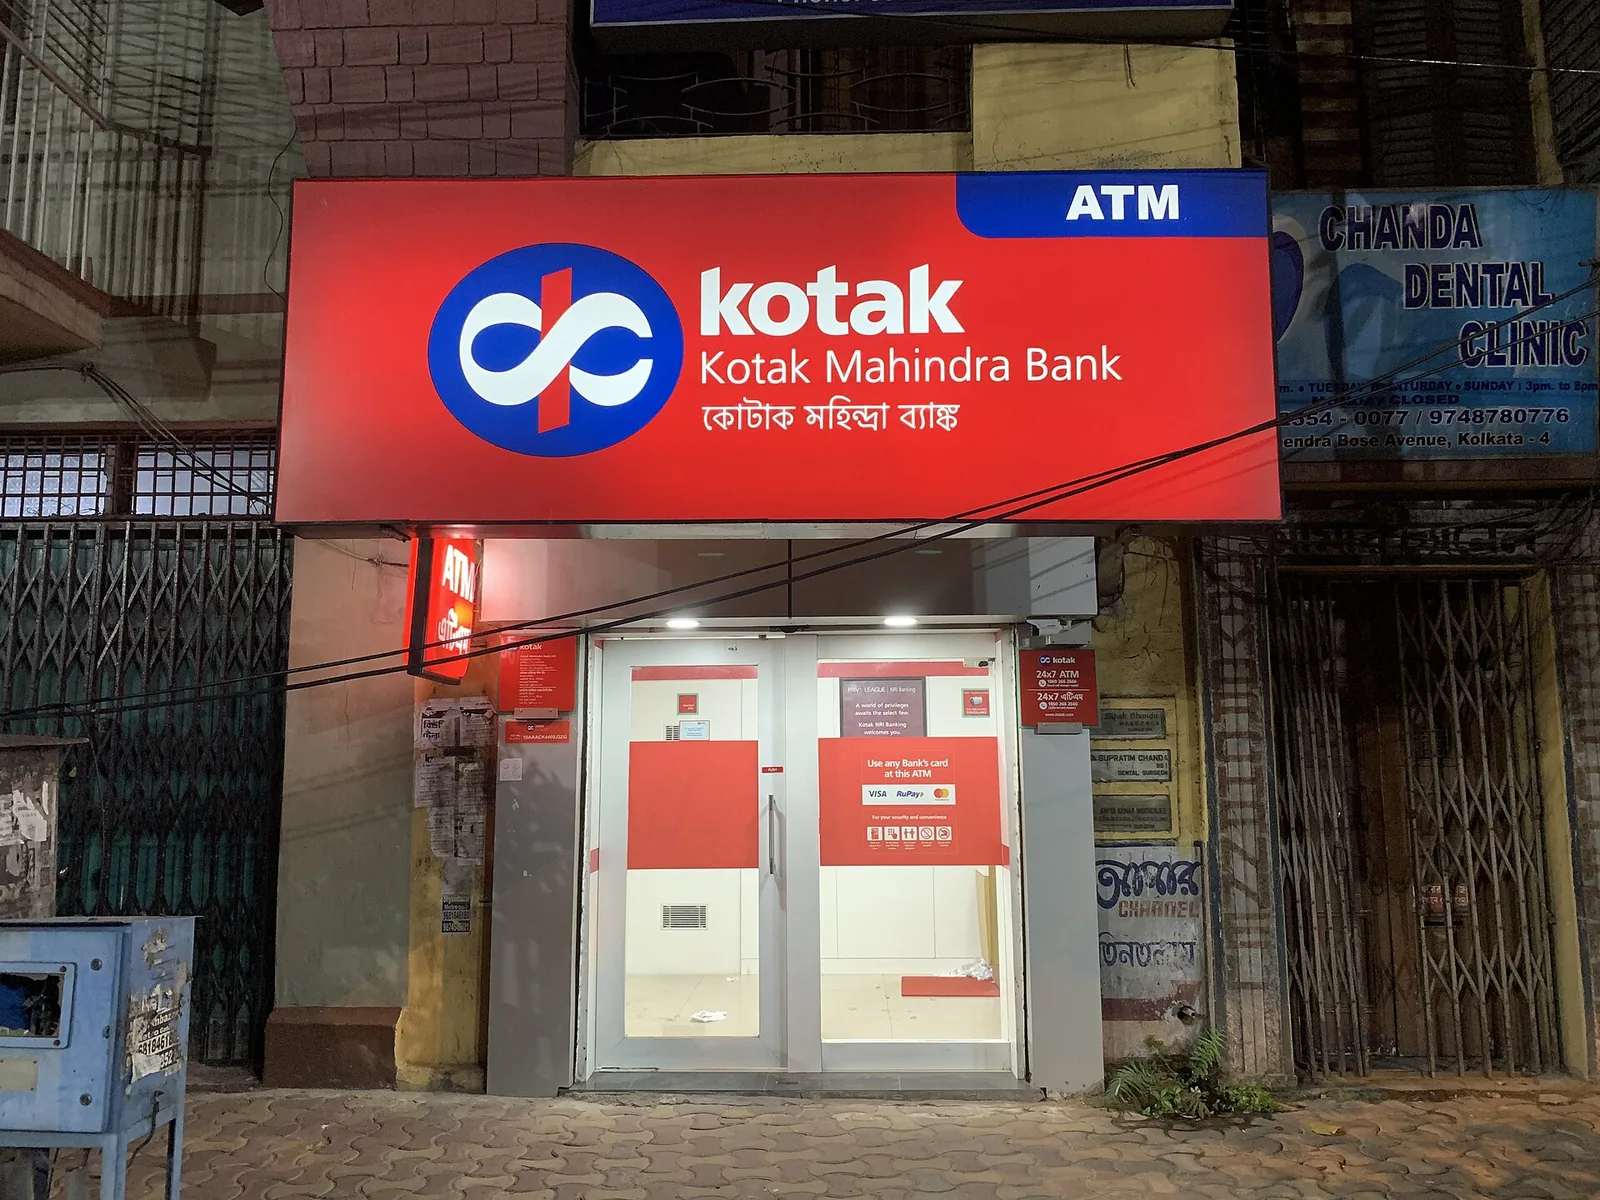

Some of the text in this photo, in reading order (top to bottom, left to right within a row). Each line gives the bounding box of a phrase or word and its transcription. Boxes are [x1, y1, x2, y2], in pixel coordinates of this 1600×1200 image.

[1066, 185, 1179, 220] ATM
[1318, 203, 1483, 251] CHANDA
[1403, 261, 1555, 309] DENTAL
[701, 263, 965, 336] kotak
[1458, 320, 1588, 368] CLINIC
[701, 345, 1122, 385] Kotak Mahindra Bank
[1463, 381, 1514, 391] SUNDAY
[1558, 381, 1570, 391] to
[1389, 394, 1460, 405] CLOSED
[701, 396, 960, 431] কোটাক মহিন্দ্রা ব্যাঙ্ক
[1354, 410, 1408, 426] 0077
[1429, 408, 1570, 426] 9748780776
[1337, 433, 1379, 448] Bose
[1384, 433, 1451, 449] Avenue,
[1458, 431, 1523, 446] Kolkata
[1539, 432, 1550, 445] 4
[442, 544, 476, 603] ATM
[1053, 656, 1076, 664] kotak
[1036, 670, 1079, 678] 24x7 ATM
[1037, 692, 1059, 701] 24x7
[867, 758, 949, 769] Use any Bank's card
[895, 769, 910, 777] this
[869, 790, 888, 798] VISA
[896, 790, 921, 799] RuPay
